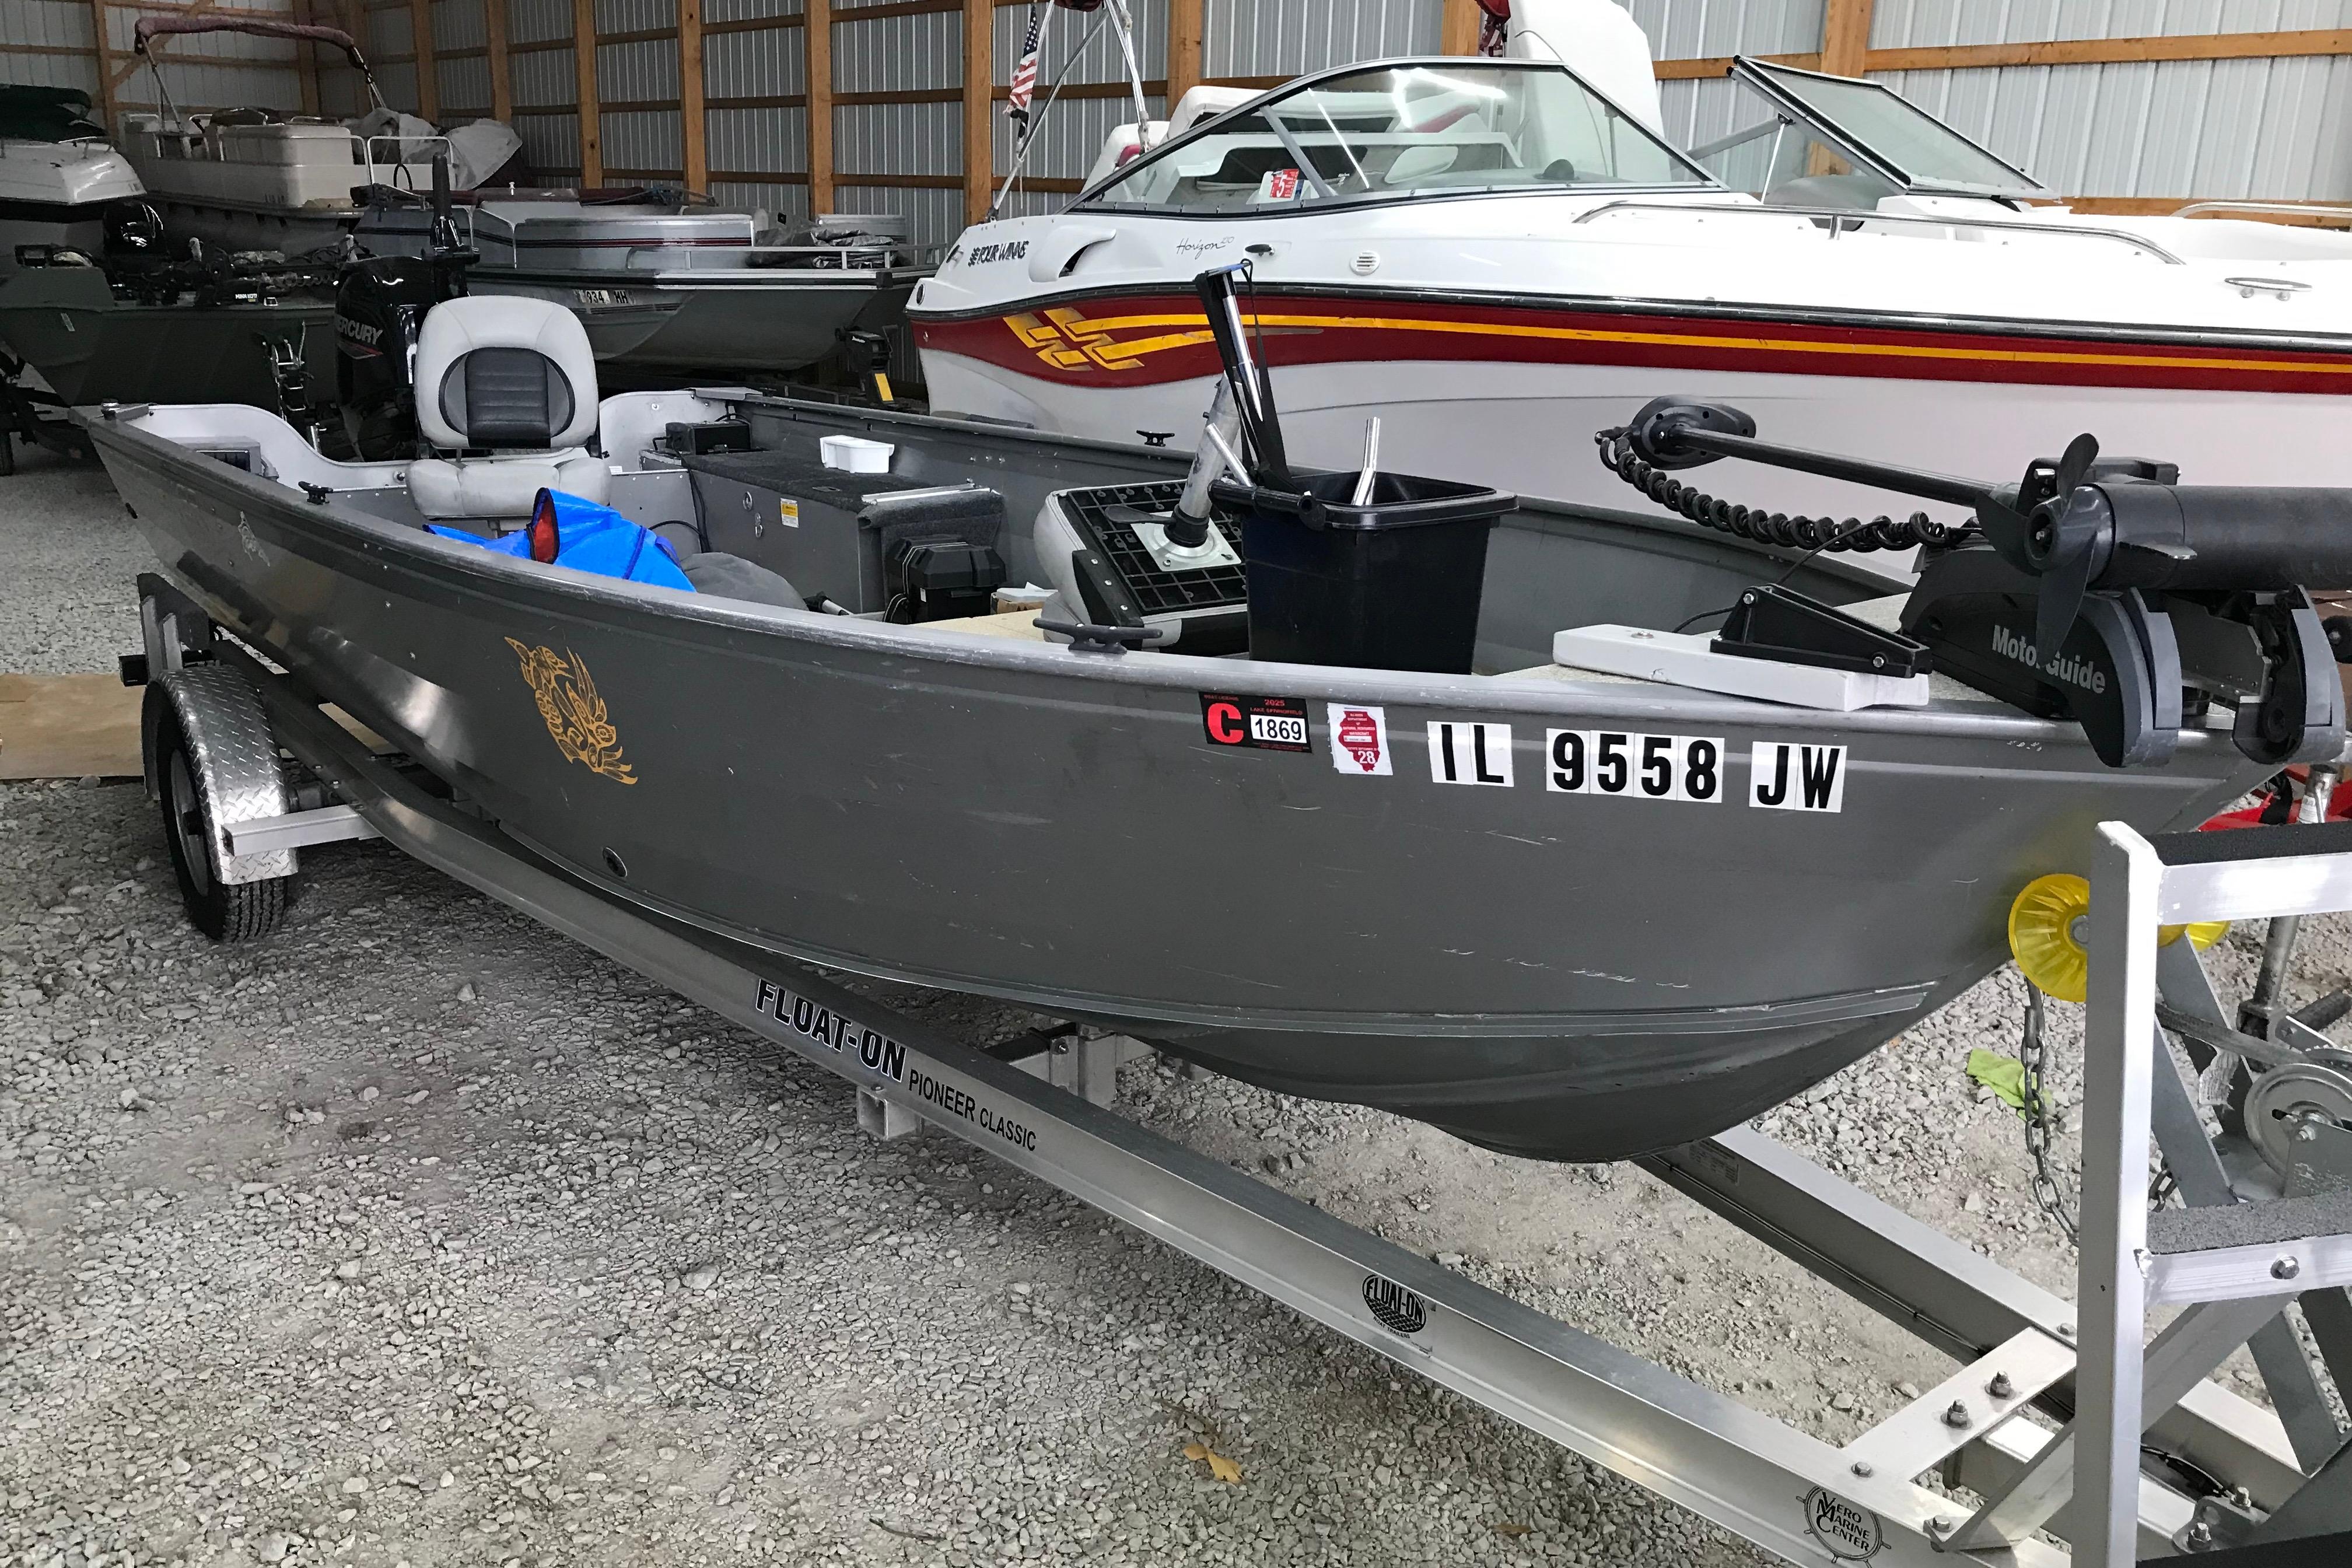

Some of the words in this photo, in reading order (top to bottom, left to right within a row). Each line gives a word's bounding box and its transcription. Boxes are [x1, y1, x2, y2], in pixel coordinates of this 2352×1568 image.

[1176, 238, 1226, 260] Horizon
[1992, 625, 2105, 694] MotoGuide
[1208, 702, 1244, 743] C
[1255, 718, 1302, 740] 1869
[1357, 751, 1376, 764] 28
[1441, 724, 1504, 783] IL
[1552, 732, 1716, 799] 9558
[1757, 745, 1839, 809] JW
[755, 978, 907, 1083] FLOAT-ON
[909, 1069, 975, 1122] PIONEER
[980, 1108, 1036, 1152] CLASSIC
[1817, 1499, 1870, 1540] MARINE
[1822, 1492, 1861, 1523] VERO
[1816, 1514, 1870, 1552] CENTER
